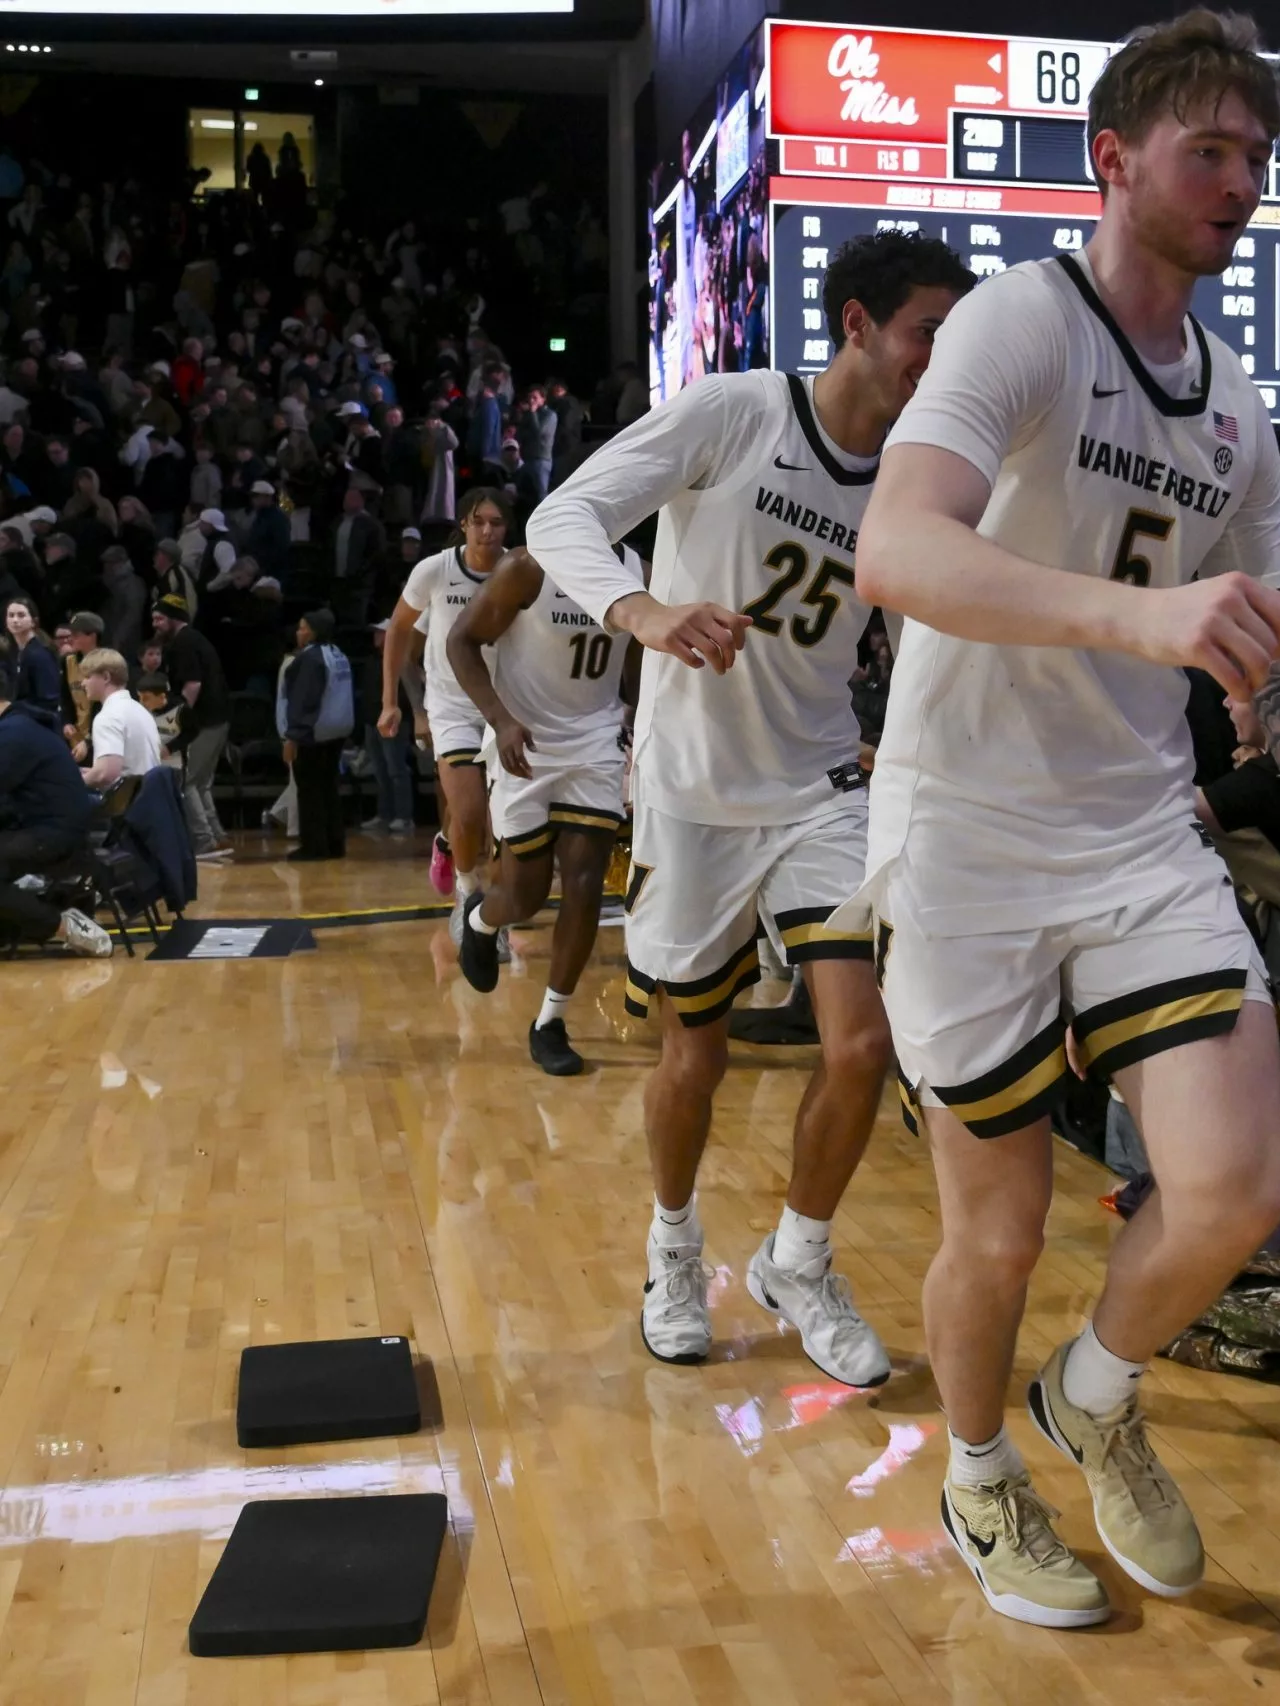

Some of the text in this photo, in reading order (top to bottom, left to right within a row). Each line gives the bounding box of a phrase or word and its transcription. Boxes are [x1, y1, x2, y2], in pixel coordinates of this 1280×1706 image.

[827, 33, 880, 78] Ole
[1036, 49, 1080, 106] 68
[839, 79, 920, 126] Miss
[1215, 449, 1233, 473] SEC
[446, 595, 473, 606] VAN
[738, 540, 856, 648] 25
[569, 631, 614, 680] 10
